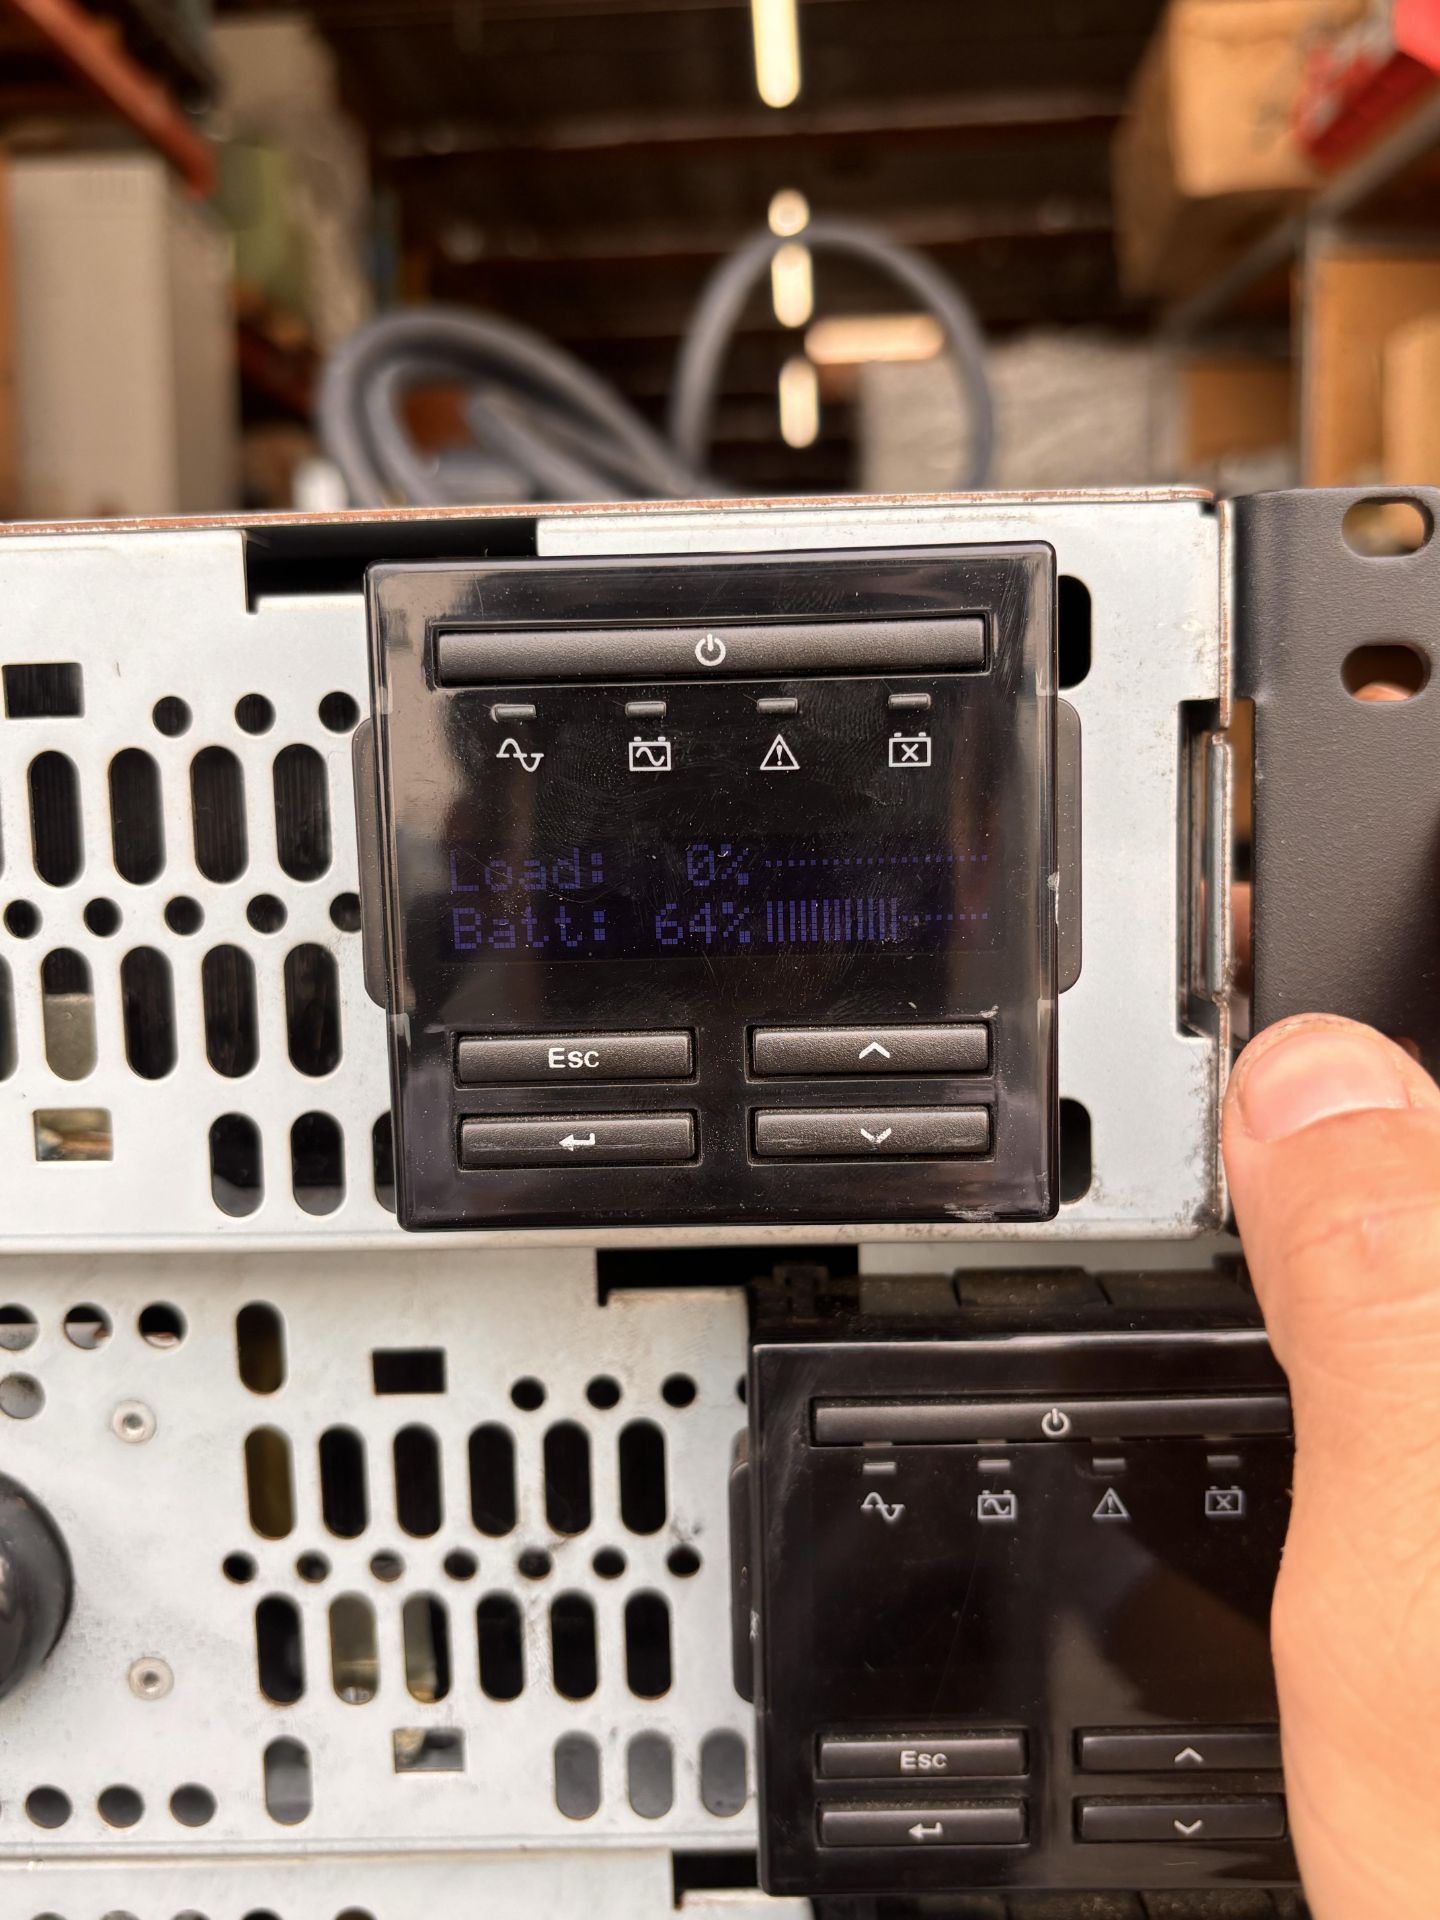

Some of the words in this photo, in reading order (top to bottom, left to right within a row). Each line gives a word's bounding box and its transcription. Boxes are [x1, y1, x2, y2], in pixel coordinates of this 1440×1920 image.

[450, 848, 604, 892] Load:
[686, 843, 750, 886] 0%
[452, 905, 606, 949] Batt:
[655, 901, 751, 944] 64%
[548, 1047, 600, 1069] Esc
[900, 1750, 948, 1771] Esc
